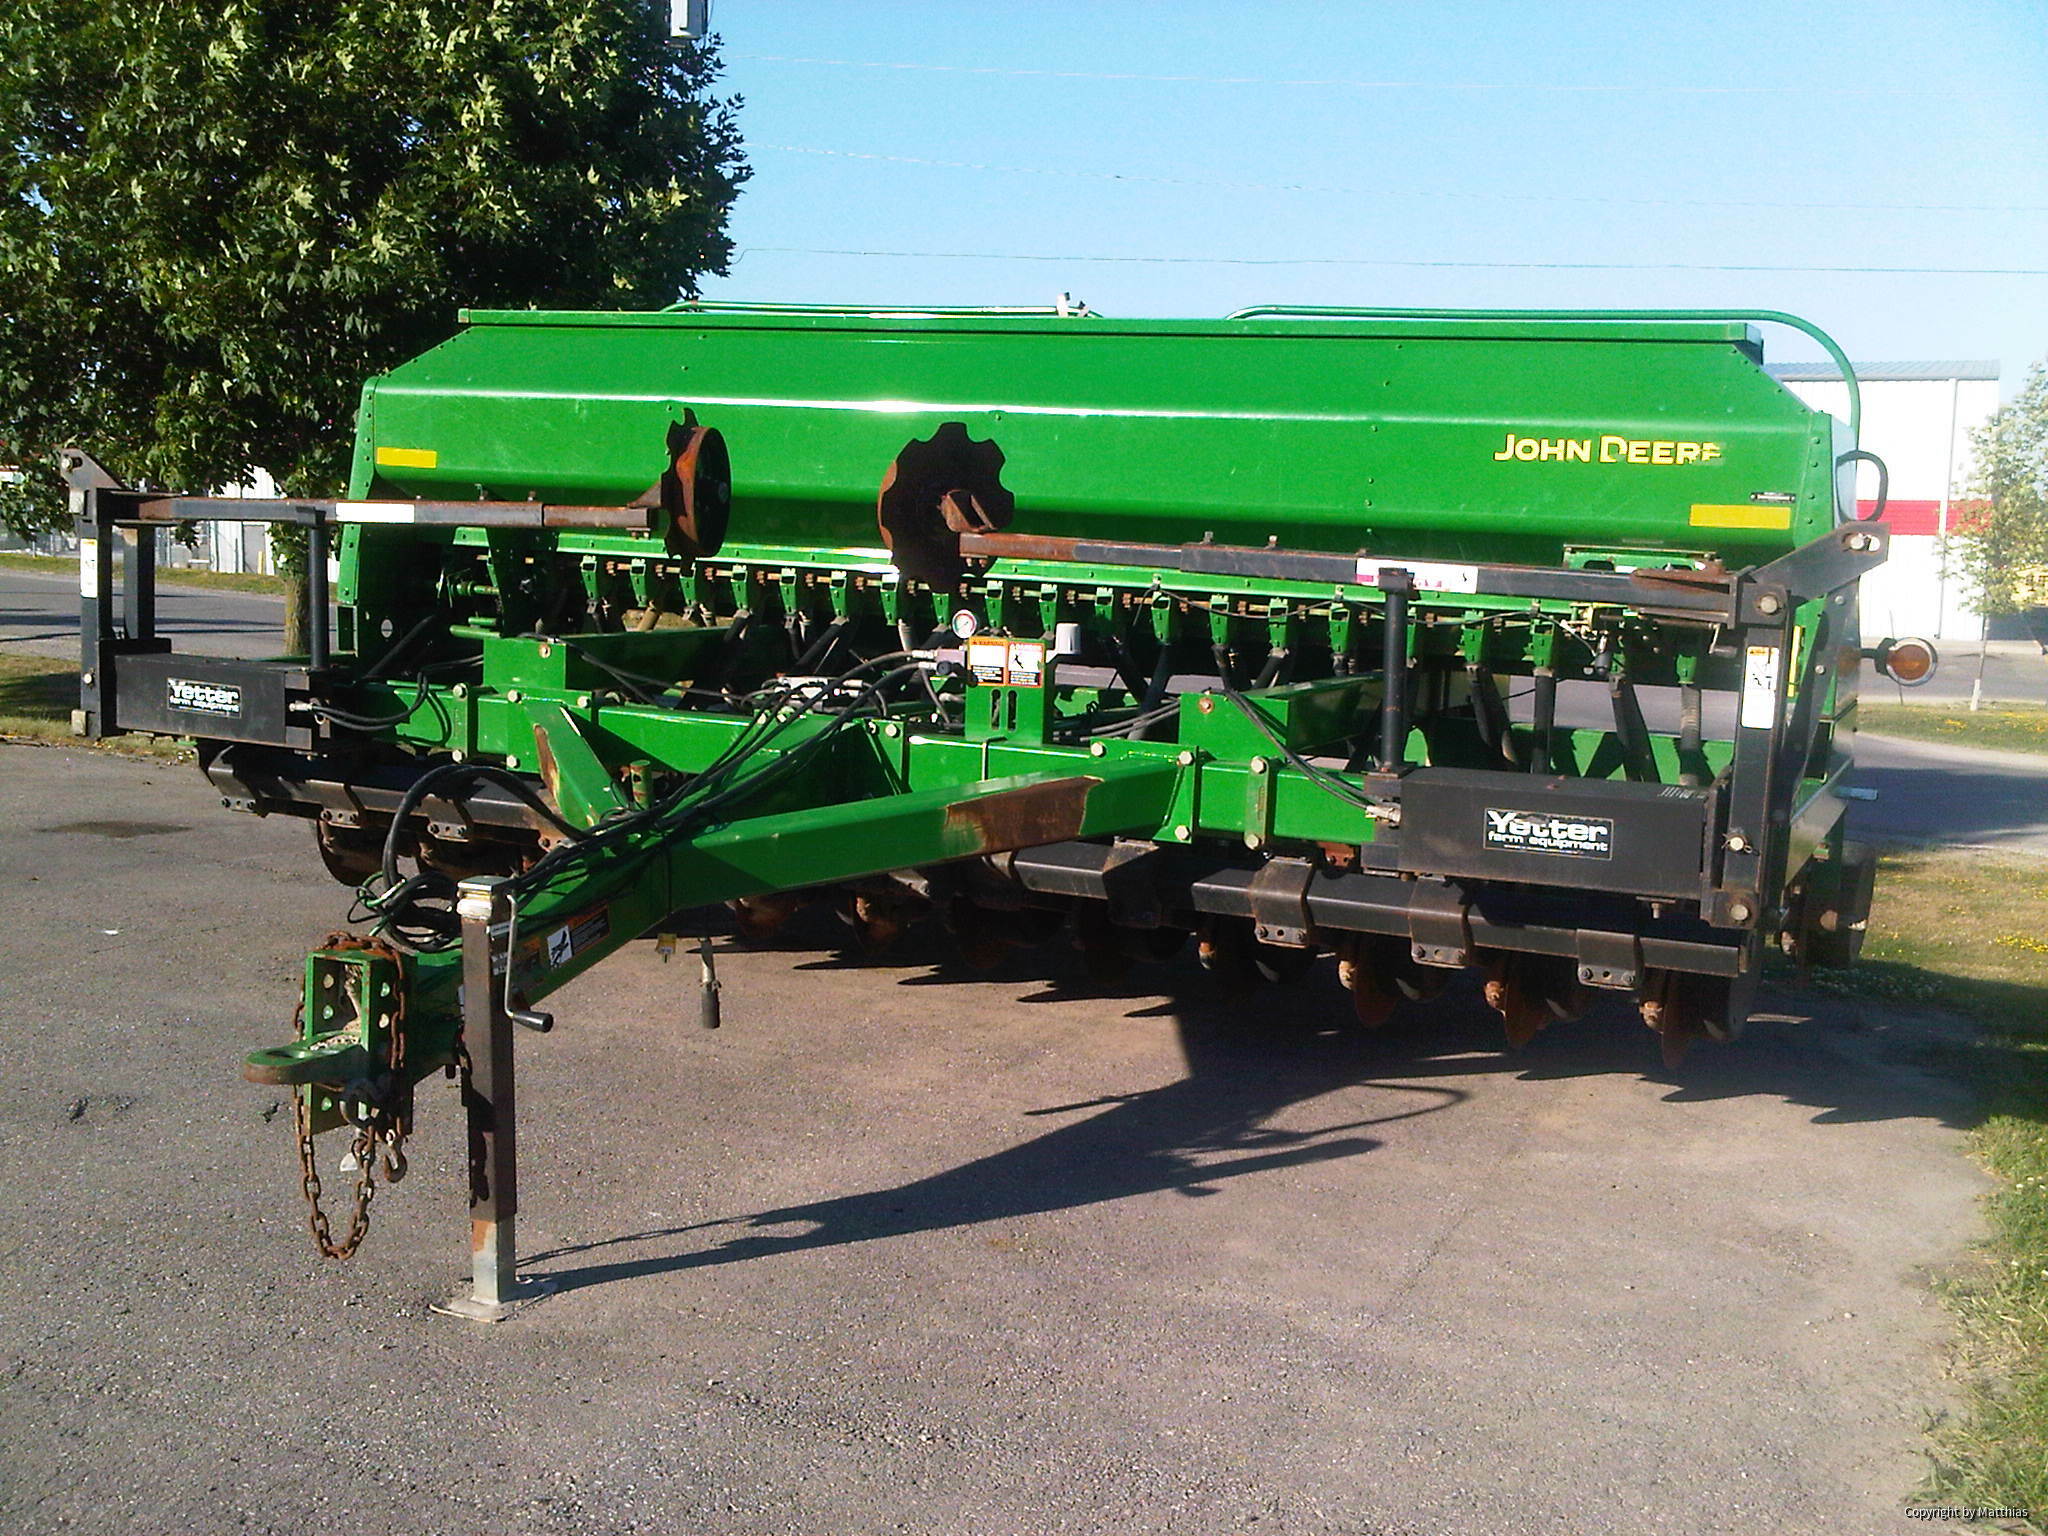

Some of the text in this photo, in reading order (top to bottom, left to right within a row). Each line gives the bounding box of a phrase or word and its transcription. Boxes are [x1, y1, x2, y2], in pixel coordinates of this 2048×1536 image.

[1494, 433, 1591, 462] JOHN
[168, 680, 239, 704] Yetter
[1487, 810, 1609, 842] Yetter
[1488, 830, 1524, 844] farm
[1528, 835, 1609, 852] equipment
